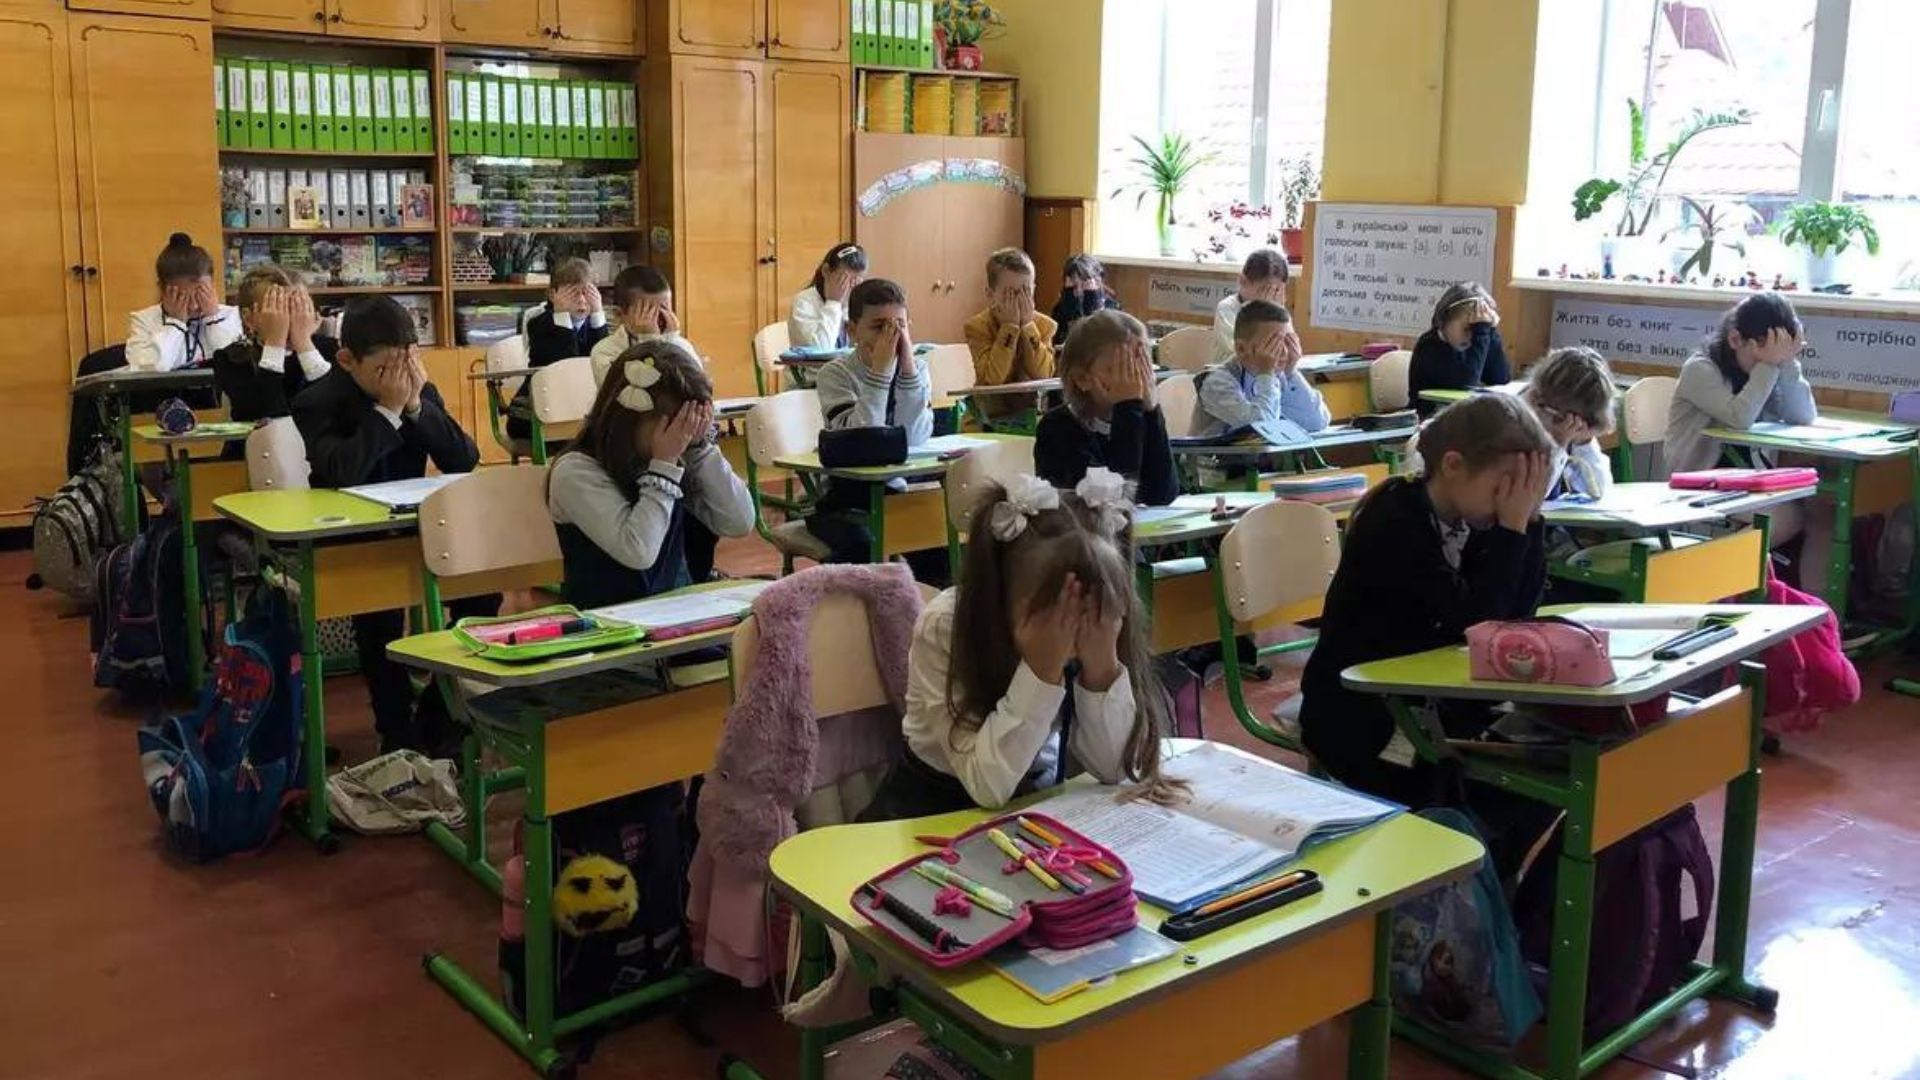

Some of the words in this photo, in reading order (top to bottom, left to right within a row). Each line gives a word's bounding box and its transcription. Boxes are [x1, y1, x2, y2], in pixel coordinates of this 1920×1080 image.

[1336, 220, 1344, 230] В
[1352, 220, 1408, 233] українській
[1418, 224, 1442, 234] мові
[1451, 226, 1483, 236] шість
[1324, 238, 1368, 249] голосних
[1333, 270, 1346, 281] На
[1353, 272, 1388, 284] письмі
[1321, 288, 1367, 299] десятьма
[1555, 311, 1600, 326] Життя
[1606, 314, 1632, 329] без
[1640, 320, 1673, 333] книг
[1579, 338, 1609, 350] хата
[1617, 339, 1642, 354] без
